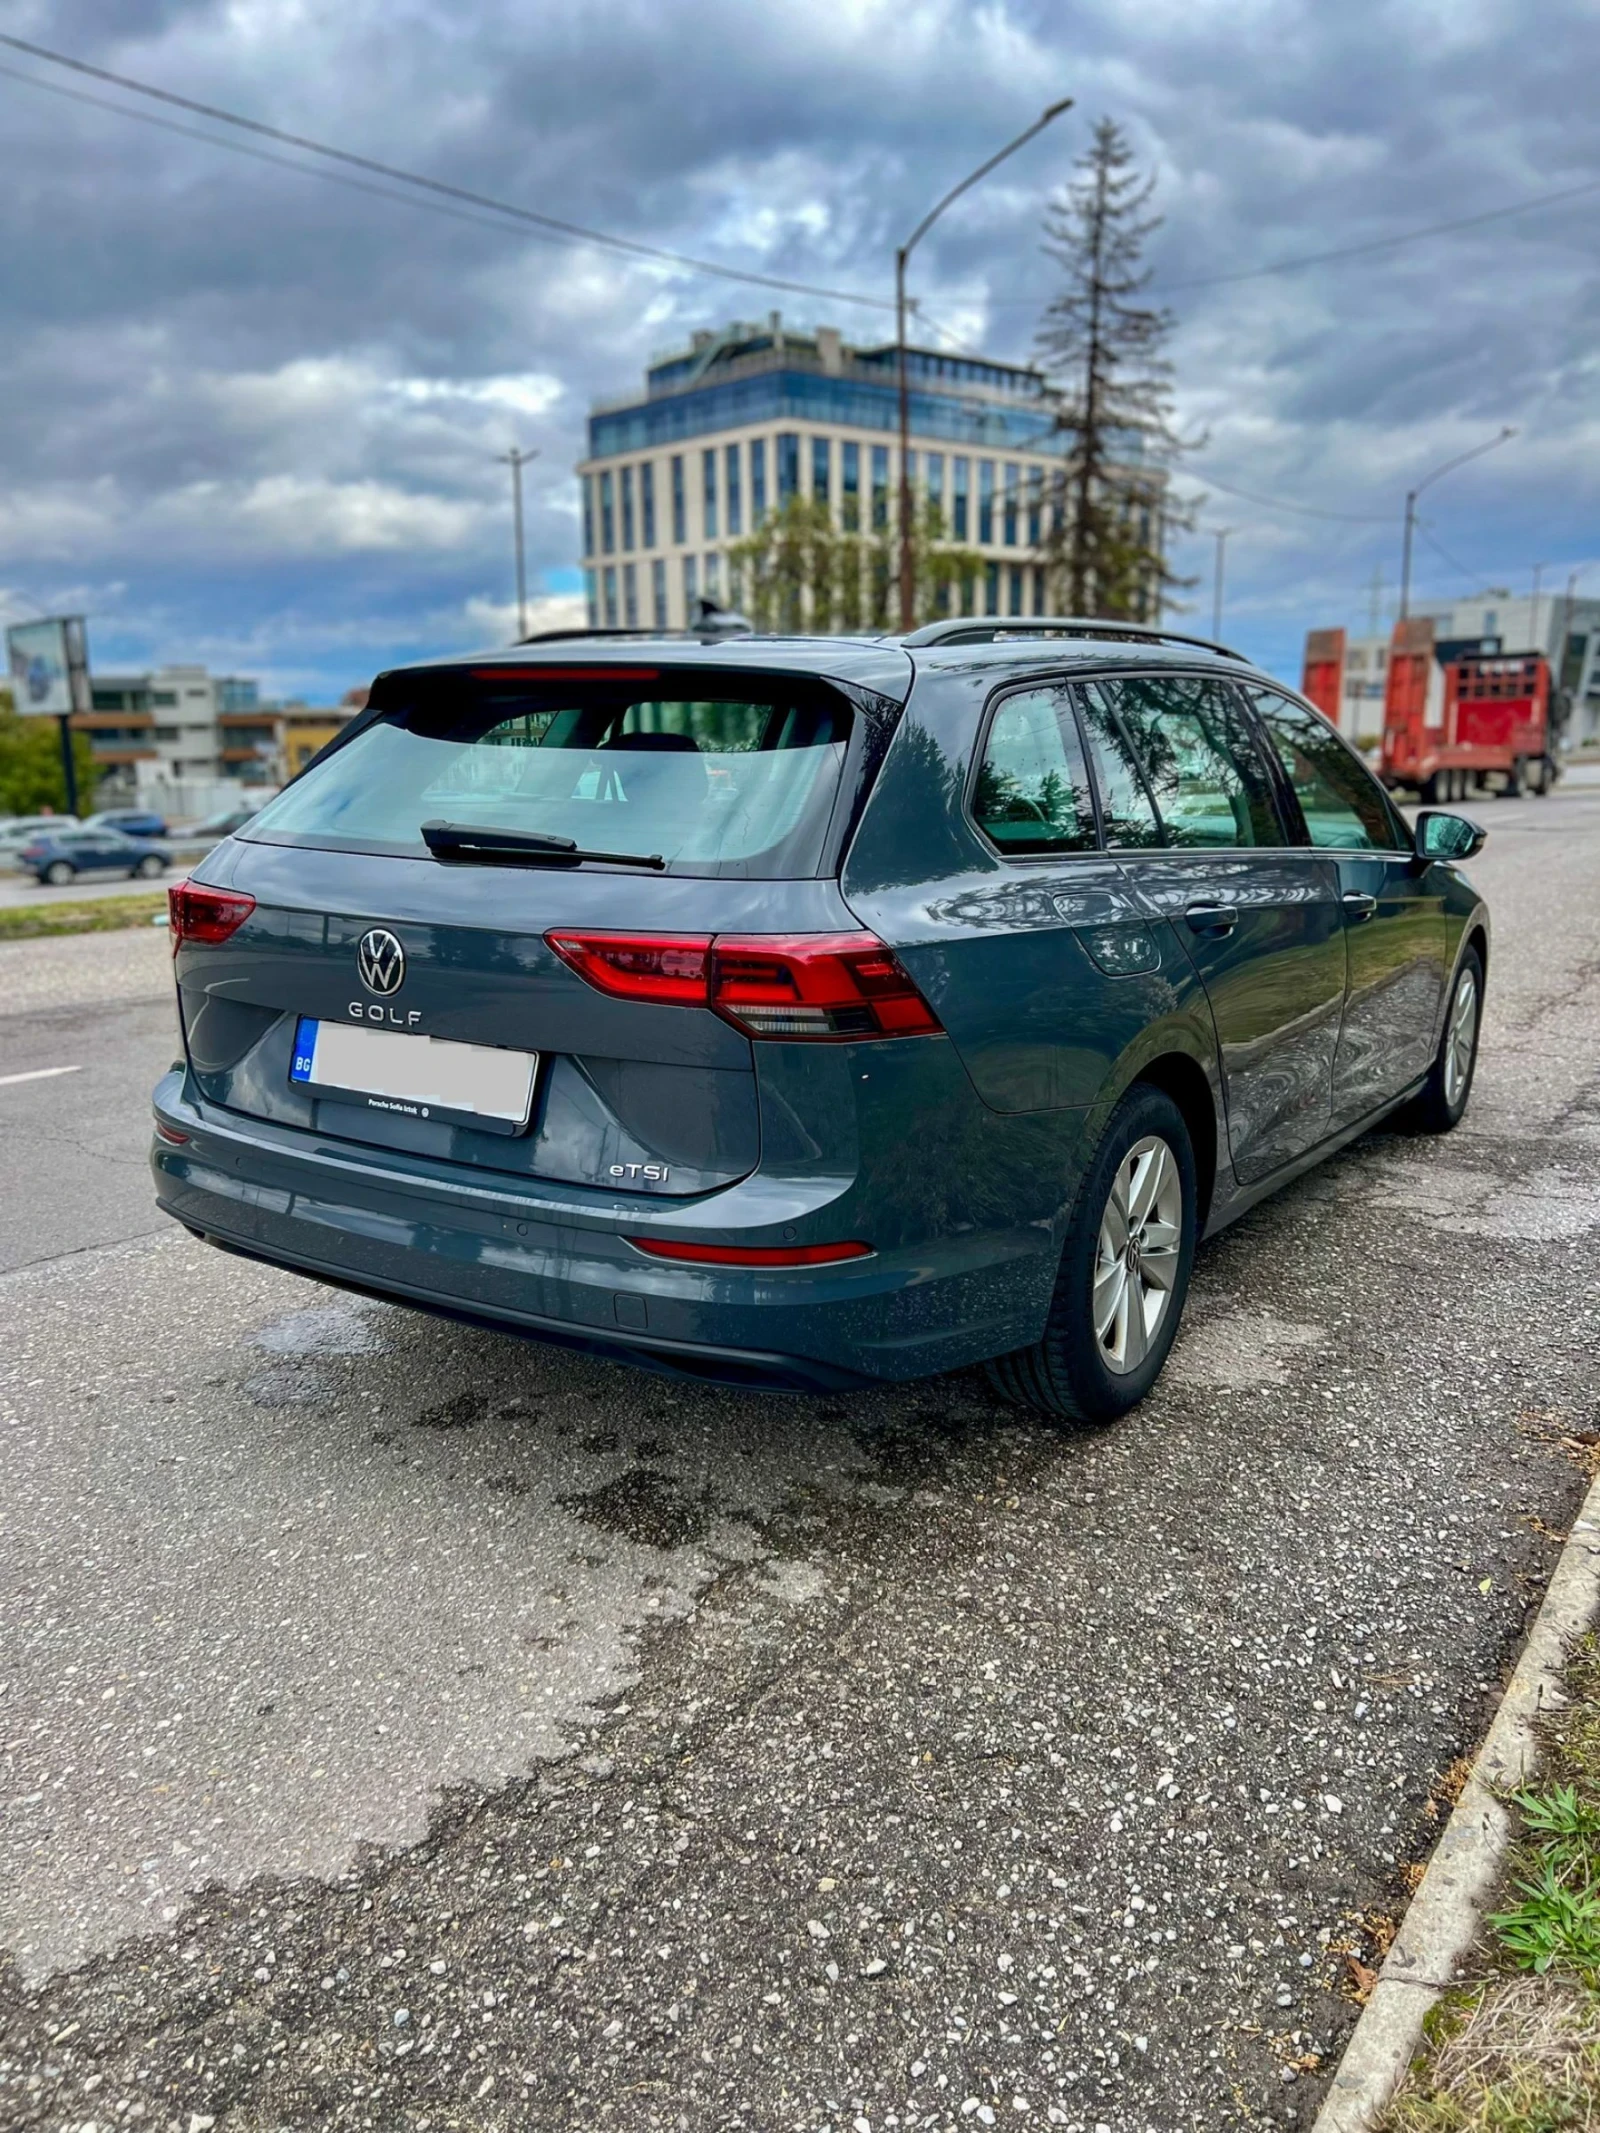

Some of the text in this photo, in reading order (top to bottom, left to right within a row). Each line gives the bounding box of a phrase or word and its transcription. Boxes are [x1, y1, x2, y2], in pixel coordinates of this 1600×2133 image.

[348, 1001, 422, 1026] GOLF
[295, 1056, 311, 1072] BG
[609, 1163, 669, 1182] eTSI
